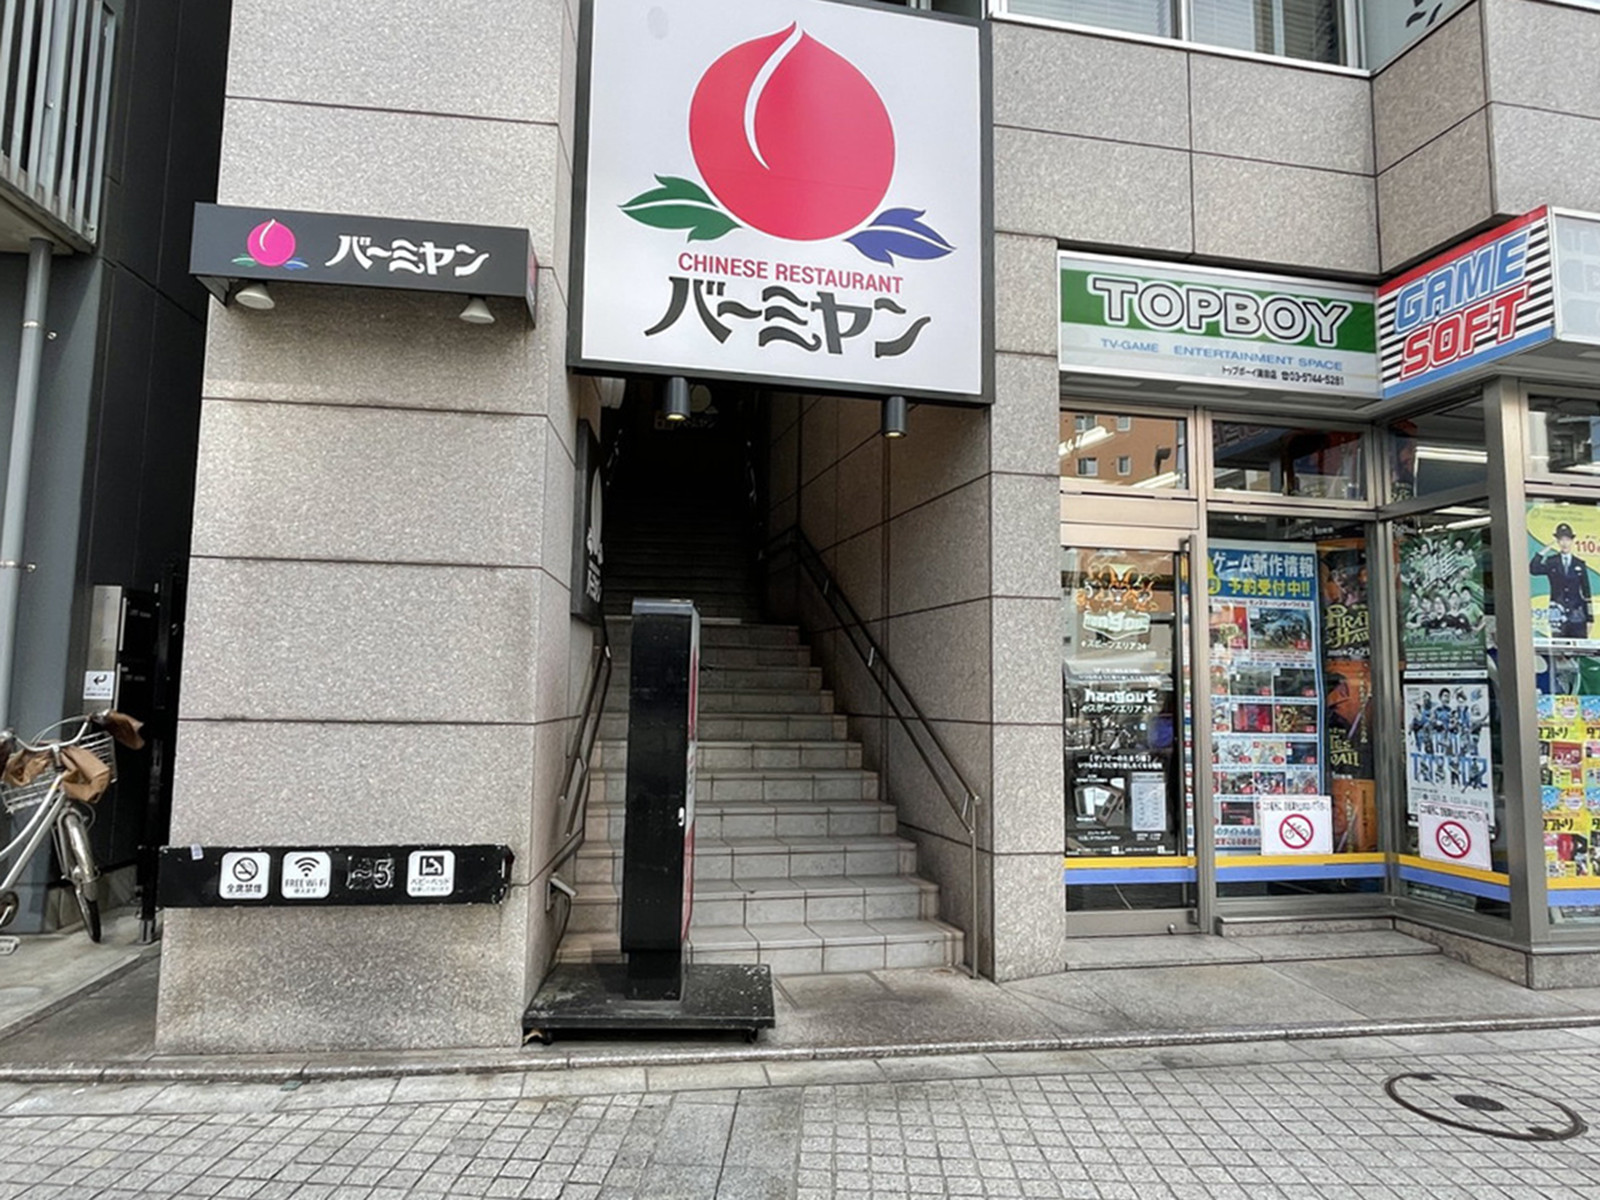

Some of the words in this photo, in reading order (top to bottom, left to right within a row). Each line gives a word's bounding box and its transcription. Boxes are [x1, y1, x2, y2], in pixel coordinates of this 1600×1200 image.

[325, 235, 490, 277] バーミヤン
[678, 252, 768, 279] CHINESE
[775, 264, 904, 294] RESTAURANT
[1395, 227, 1530, 334] GAME
[644, 276, 932, 359] バーミヤン
[1091, 276, 1350, 345] TOPBOY
[1400, 281, 1530, 380] SOFT
[1101, 338, 1160, 353] TV-GAME
[1174, 345, 1294, 366] ENTERTAINMENT
[1298, 357, 1343, 371] SPACE
[1213, 551, 1315, 578] ゲーム新作情報
[1575, 540, 1600, 553] 110
[1084, 689, 1158, 704] hangout
[285, 878, 304, 888] FREE
